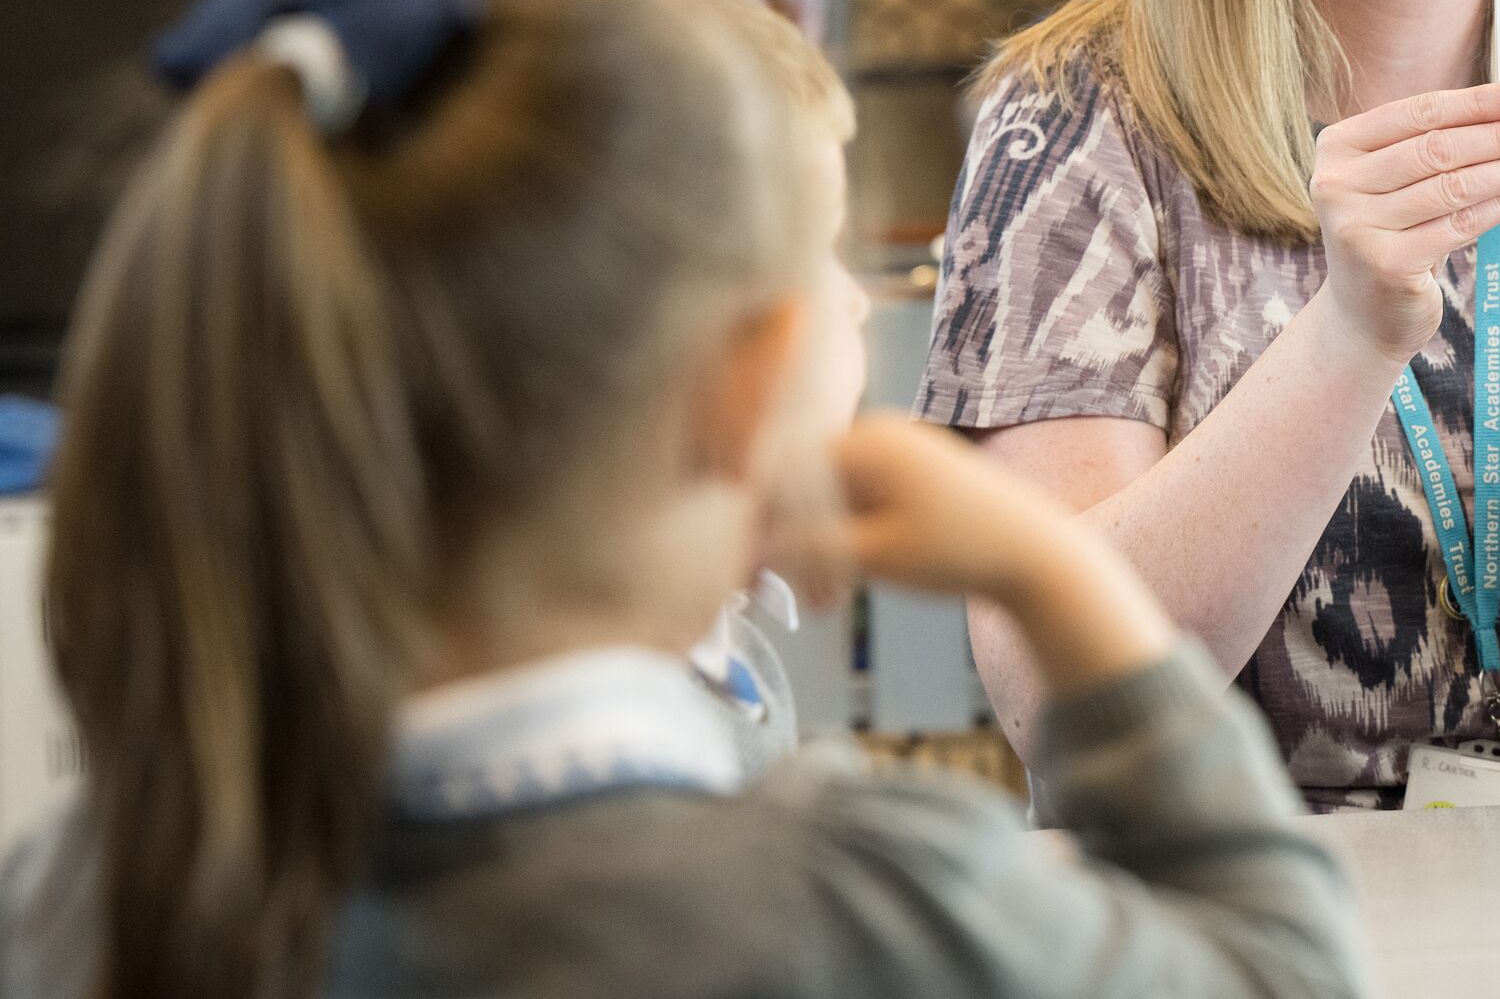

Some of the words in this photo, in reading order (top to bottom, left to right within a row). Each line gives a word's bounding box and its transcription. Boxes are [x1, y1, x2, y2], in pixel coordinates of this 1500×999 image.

[1483, 262, 1500, 314] Trust
[1482, 324, 1500, 431] Academies
[1411, 424, 1455, 531] Academies
[1449, 541, 1475, 595] Trust
[1482, 444, 1500, 485] Star
[1482, 499, 1499, 590] Northern
